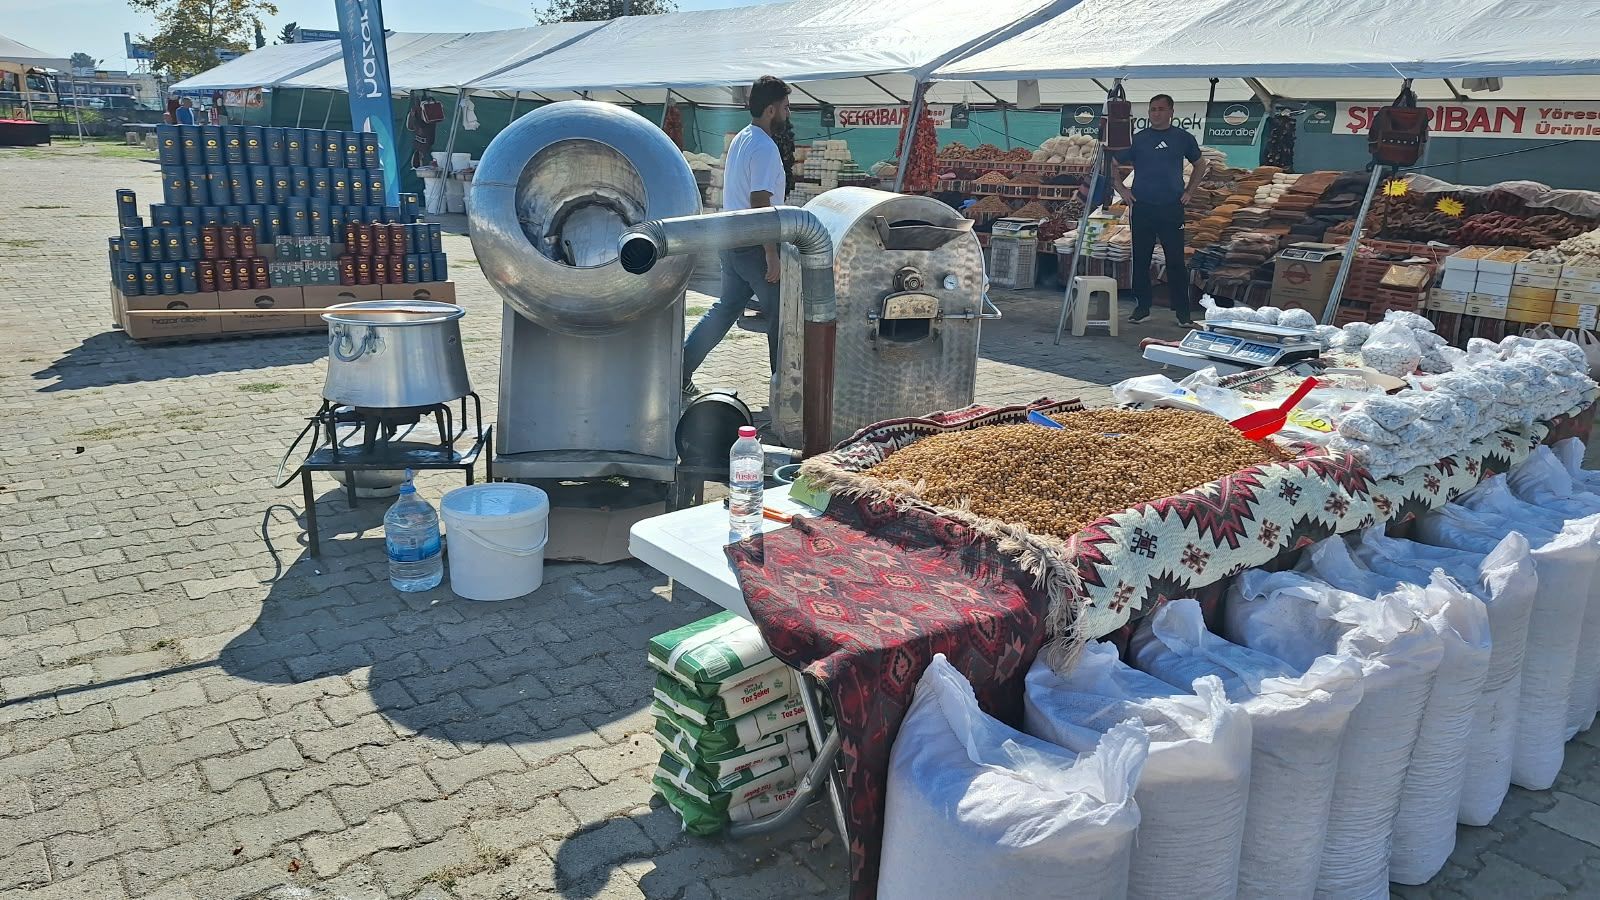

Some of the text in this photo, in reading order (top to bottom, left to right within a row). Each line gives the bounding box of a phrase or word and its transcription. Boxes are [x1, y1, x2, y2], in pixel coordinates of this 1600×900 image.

[1539, 107, 1600, 120] Yöres
[741, 687, 770, 705] Toz Şeker
[781, 711, 794, 719] Toz
[793, 706, 805, 717] Şek
